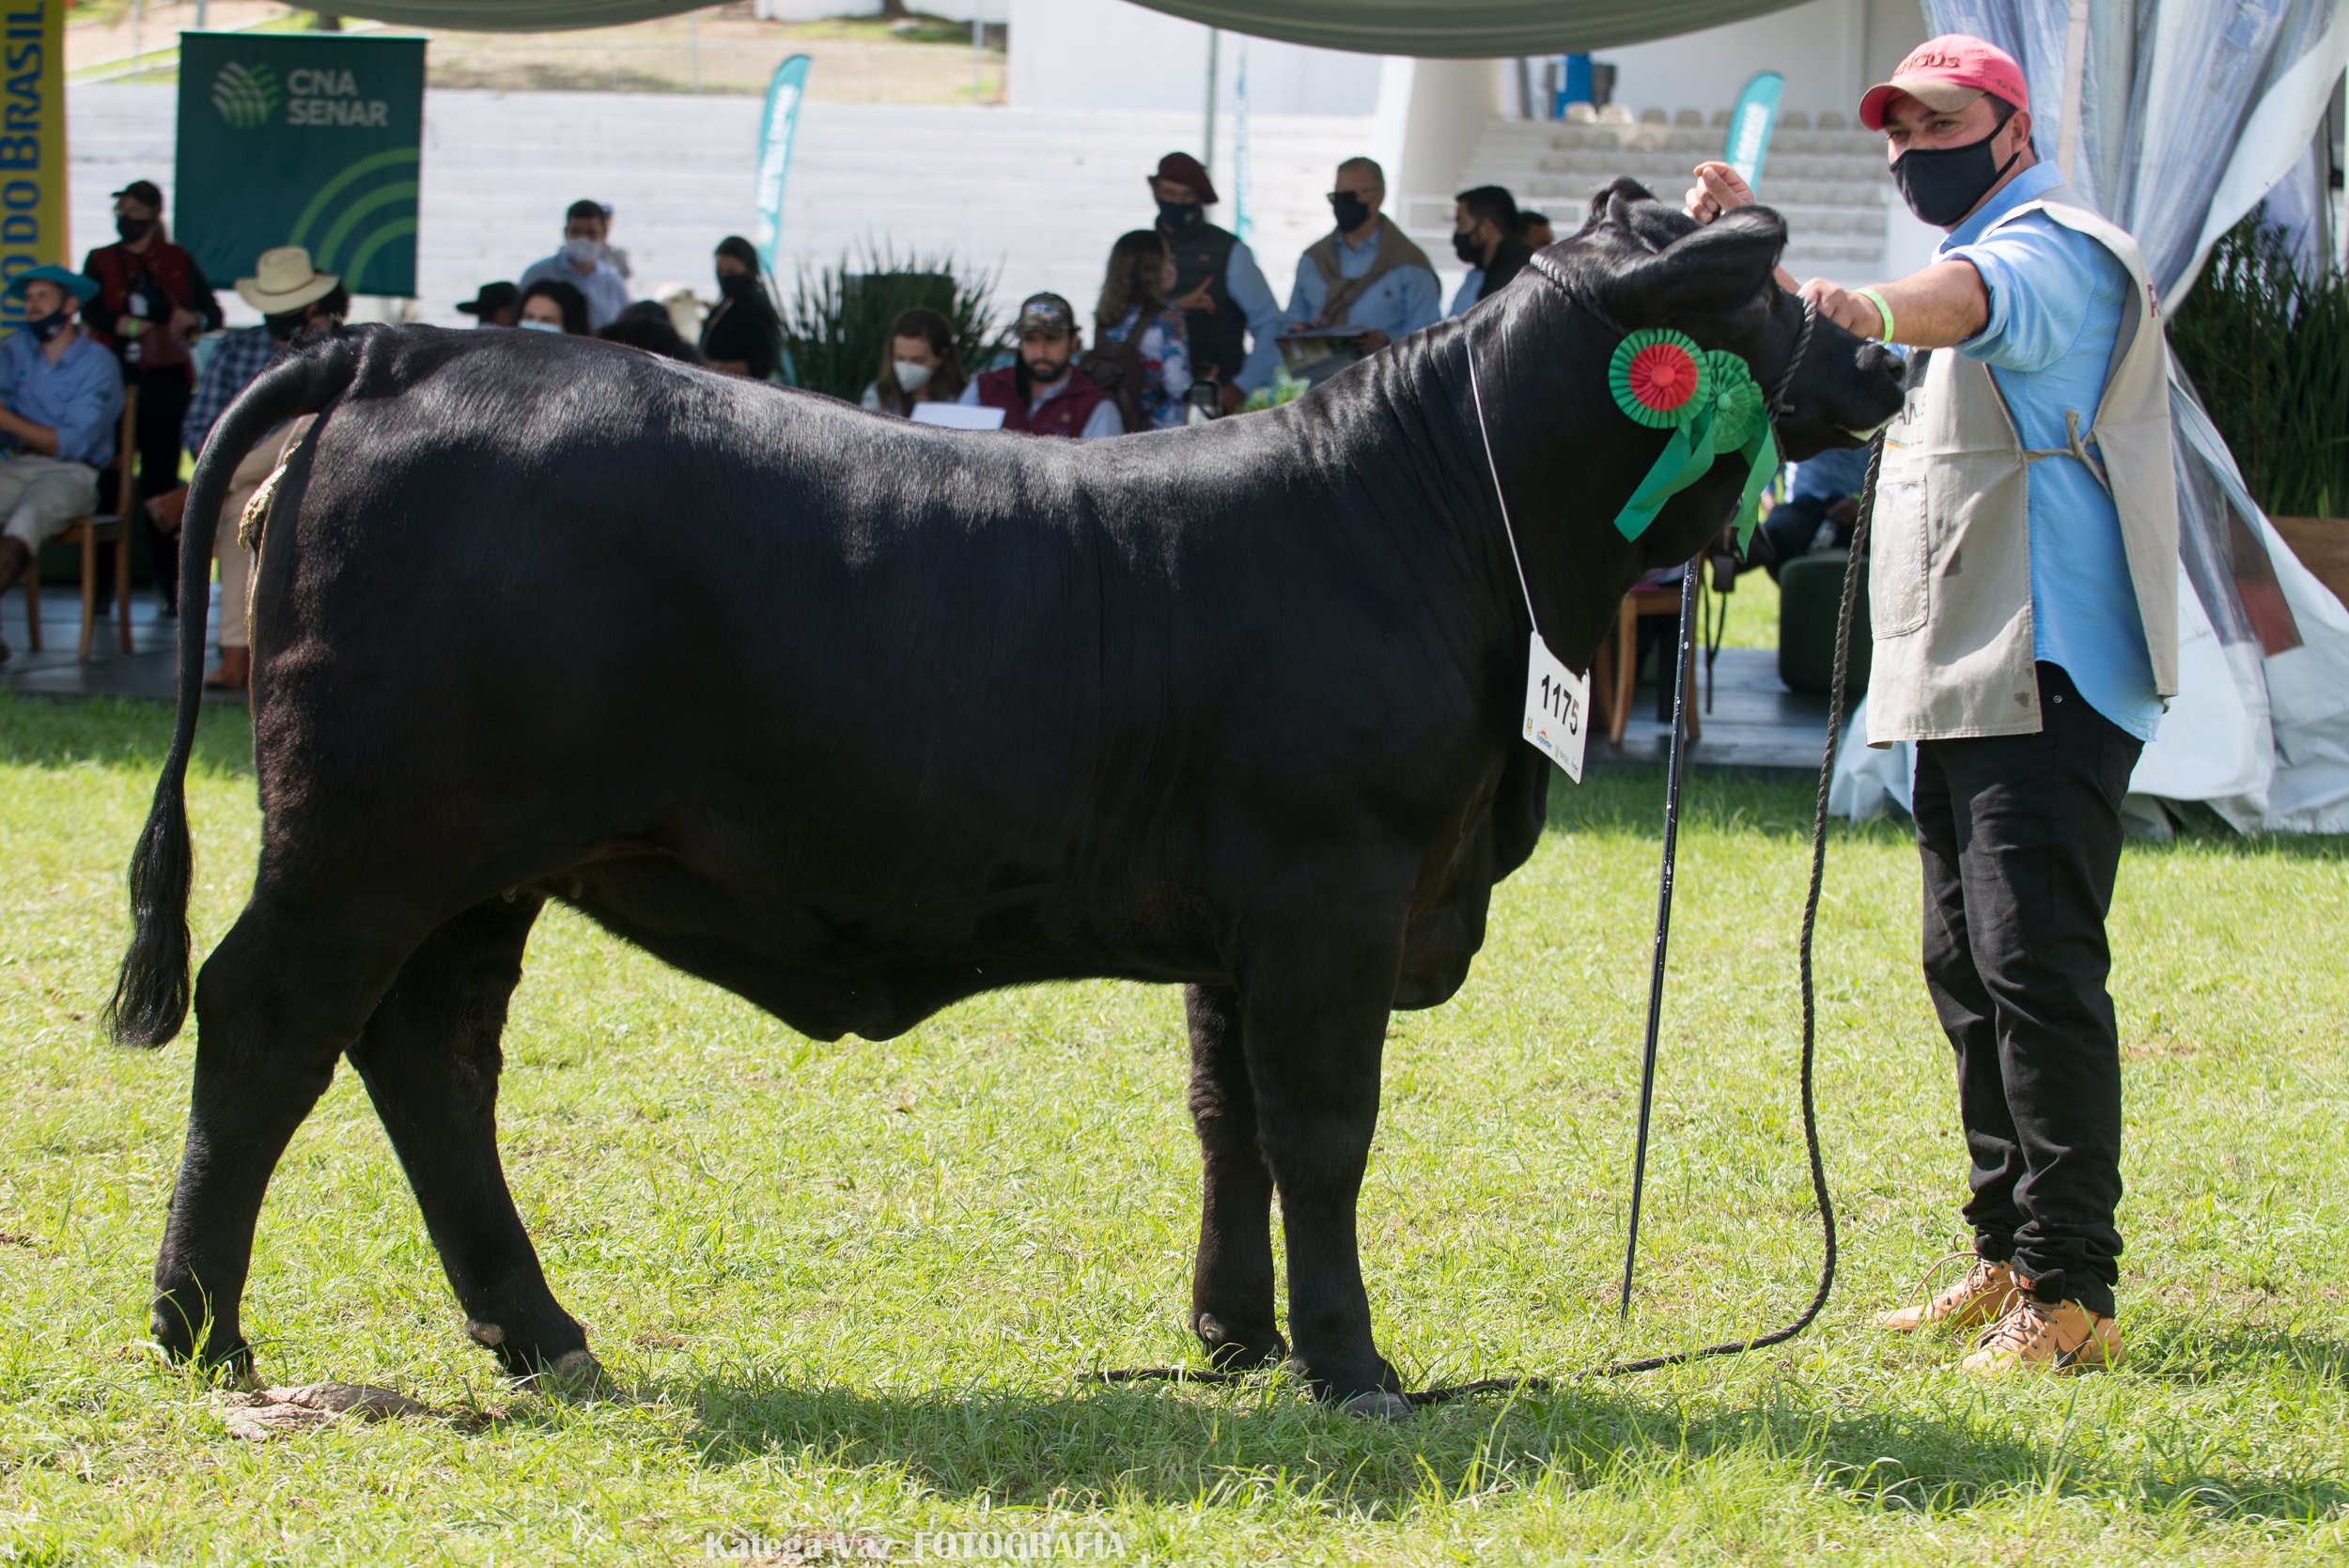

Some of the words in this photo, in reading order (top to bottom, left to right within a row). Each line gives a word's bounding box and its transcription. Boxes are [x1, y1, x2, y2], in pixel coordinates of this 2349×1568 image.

[0, 1, 45, 171] BRASIL
[286, 99, 388, 127] SENAR
[287, 69, 358, 96] CNA
[2, 180, 39, 244] DO
[1541, 674, 1579, 736] 1175
